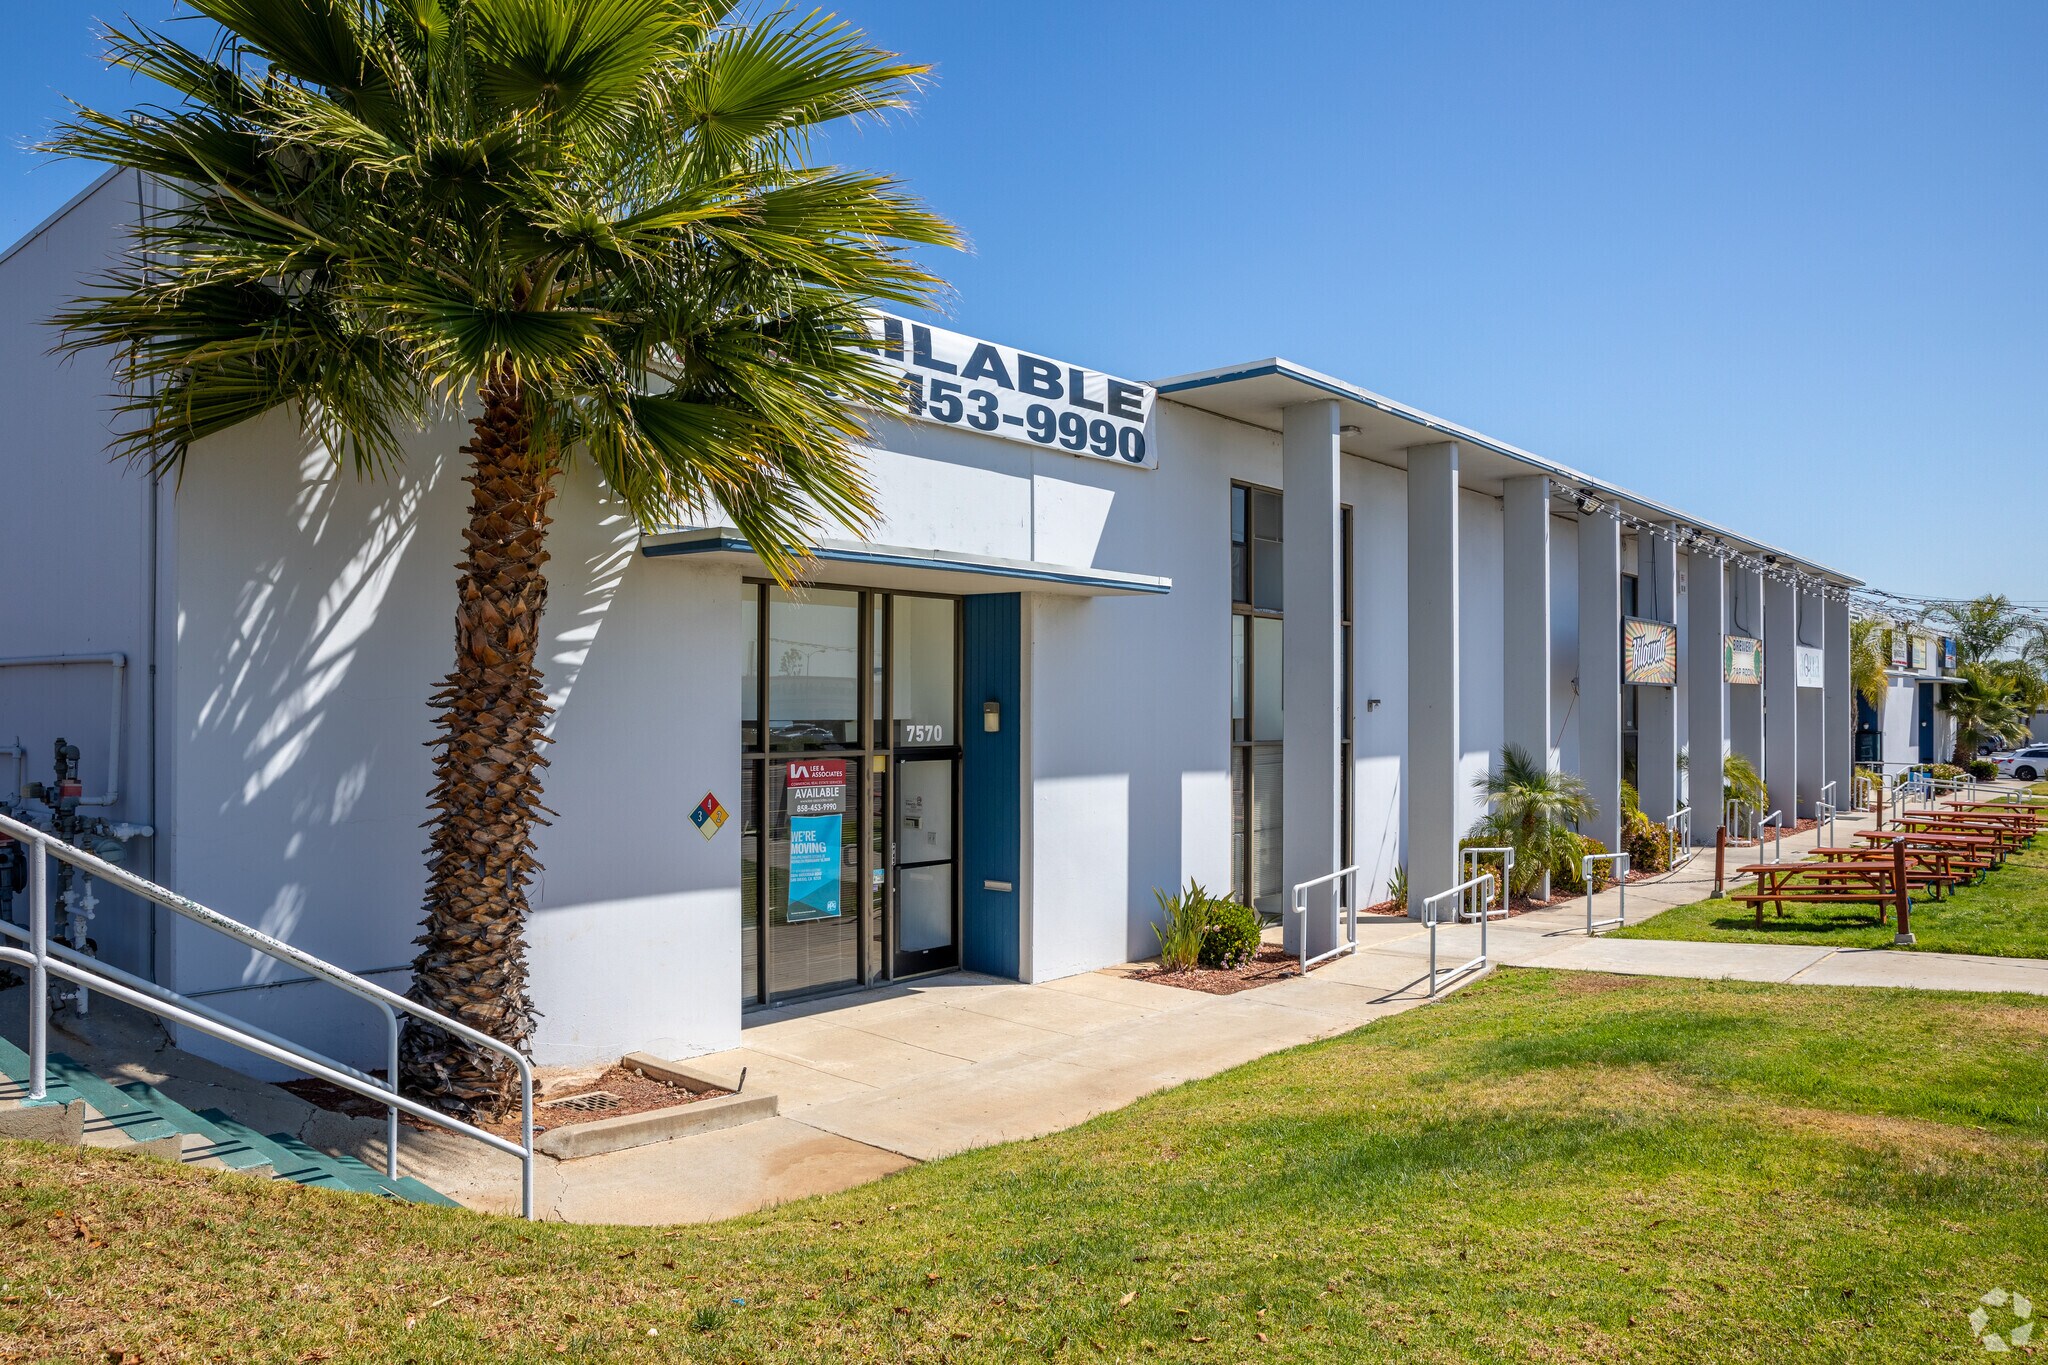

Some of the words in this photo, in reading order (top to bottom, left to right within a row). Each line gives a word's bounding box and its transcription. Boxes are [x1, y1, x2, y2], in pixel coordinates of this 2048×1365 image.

[833, 312, 1144, 423] ILABLE
[1632, 627, 1668, 674] Kilowatt
[906, 725, 943, 742] 7570
[795, 787, 839, 799] AVAILABLE
[707, 799, 713, 811] 4
[796, 803, 837, 813] 858-453-9990
[697, 811, 703, 822] 3
[715, 811, 723, 823] 2
[791, 842, 827, 855] MOVING
